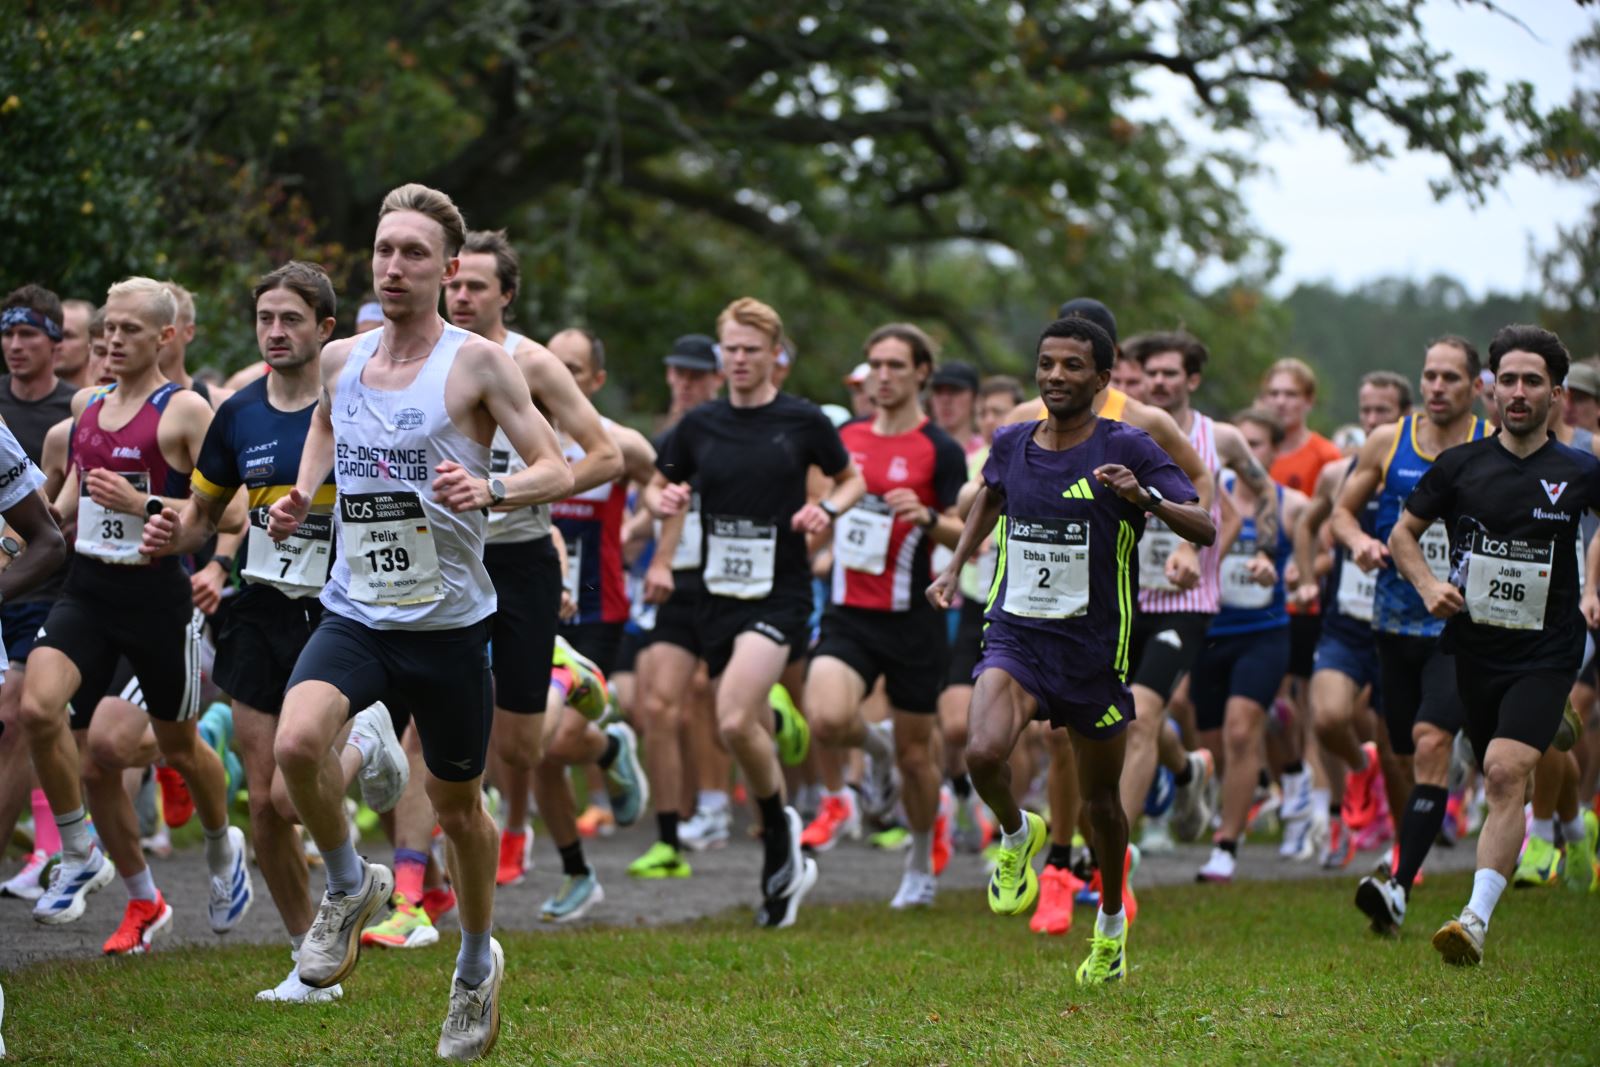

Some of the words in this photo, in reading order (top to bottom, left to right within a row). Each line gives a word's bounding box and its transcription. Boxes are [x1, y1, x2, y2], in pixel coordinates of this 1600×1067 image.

[336, 443, 428, 465] EZ-DISTANCE
[338, 461, 379, 479] CARDIO
[388, 466, 428, 481] CLUB
[345, 498, 374, 519] tcs
[375, 502, 419, 511] CONSULTANCY
[376, 510, 406, 518] SERVICES
[259, 508, 270, 525] tc
[102, 520, 124, 539] 33
[370, 530, 399, 542] Felix
[847, 528, 866, 546] 43
[1013, 522, 1030, 537] tcs
[1482, 535, 1508, 556] tcs
[365, 547, 410, 573] 139
[1023, 550, 1046, 561] Ebba
[1049, 552, 1071, 563] Tulu
[279, 557, 293, 578] 7
[723, 557, 753, 578] 323
[1498, 566, 1522, 578] João
[1037, 567, 1051, 589] 2
[1489, 580, 1526, 602] 296
